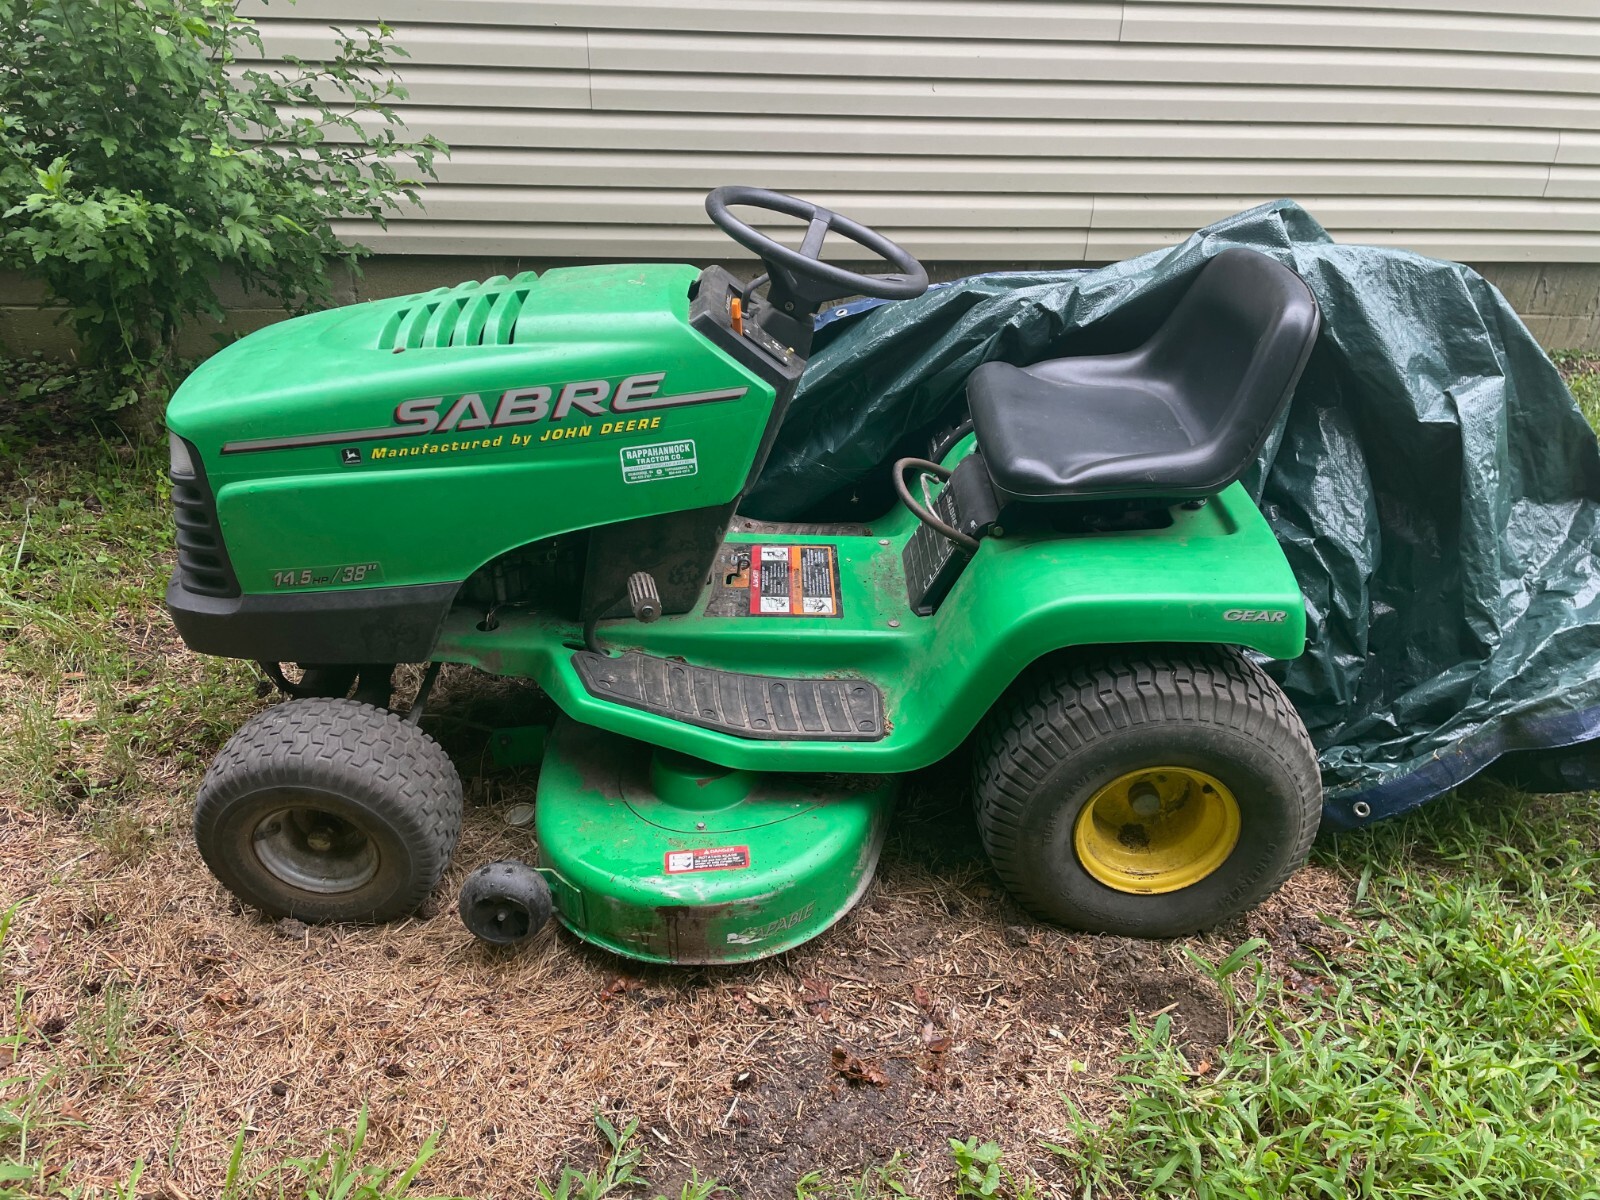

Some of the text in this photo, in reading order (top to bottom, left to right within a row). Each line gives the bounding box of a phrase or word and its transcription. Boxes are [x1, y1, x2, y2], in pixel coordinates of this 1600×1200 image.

[394, 371, 667, 436] SABRE
[371, 416, 662, 460] Manufactured by JOHN DEERE
[626, 443, 690, 459] RAPPAHANNOCK
[636, 455, 669, 464] TRACTOR
[1223, 608, 1288, 623] GEAR
